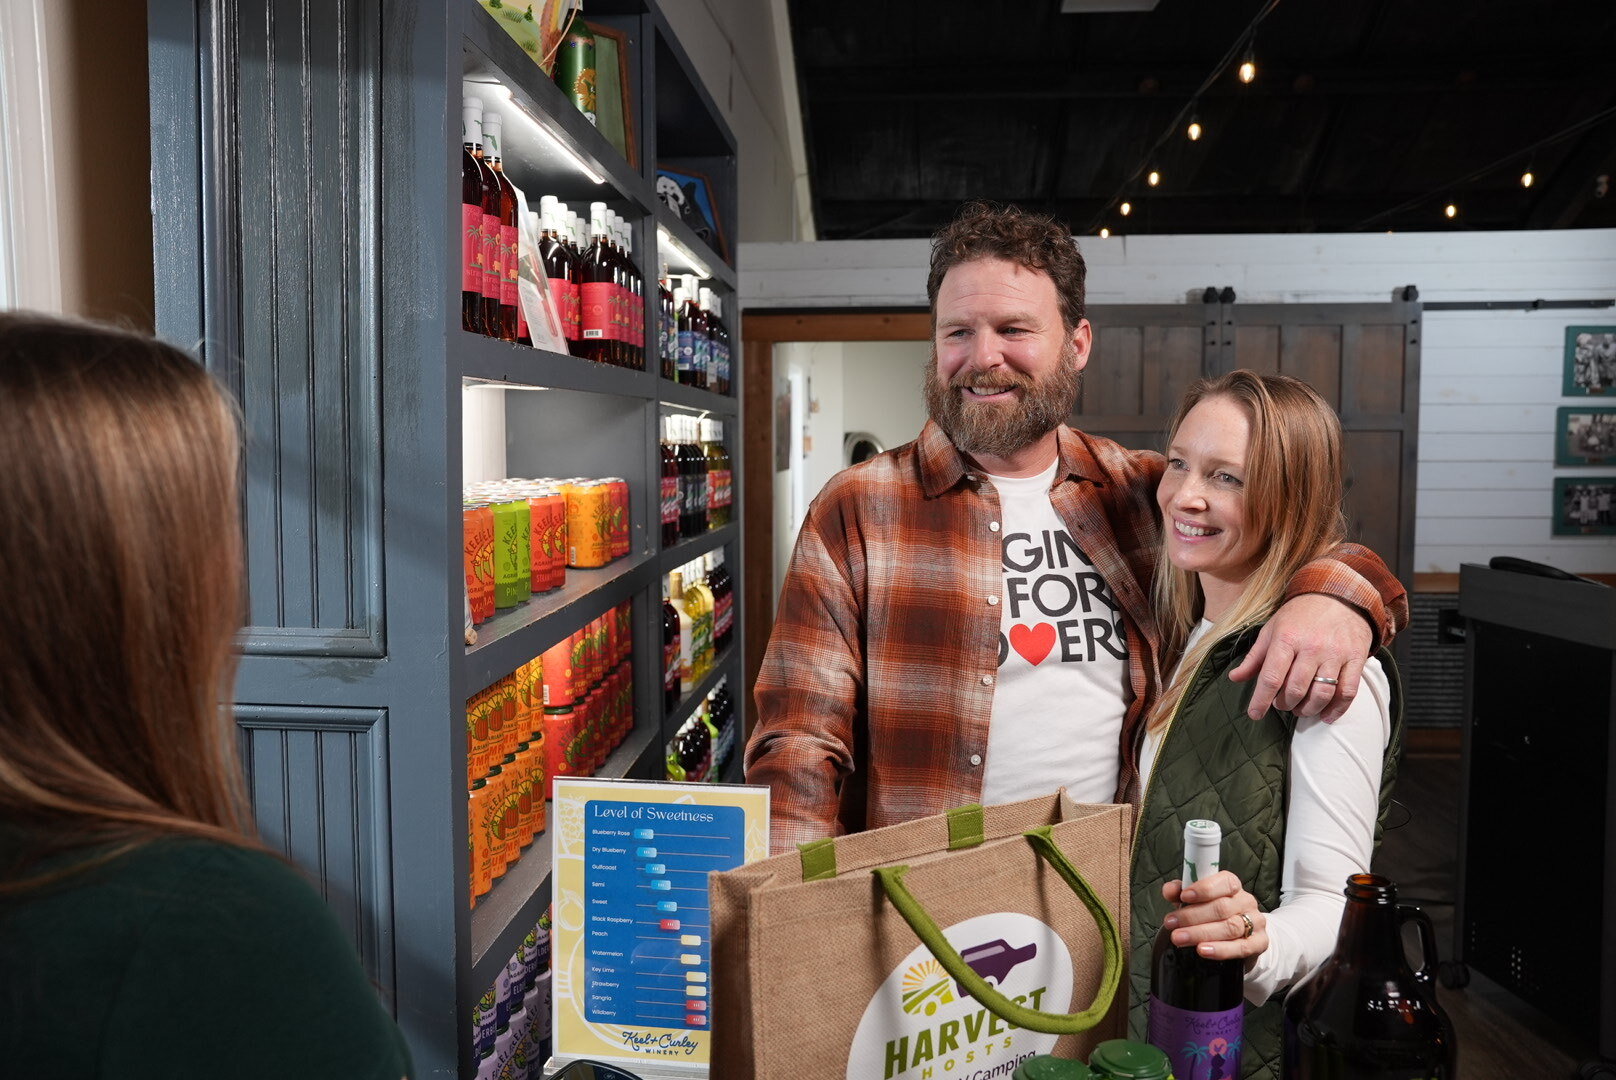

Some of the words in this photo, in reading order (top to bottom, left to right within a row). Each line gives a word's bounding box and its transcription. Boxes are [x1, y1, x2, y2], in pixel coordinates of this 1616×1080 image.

[1002, 530, 1094, 573] GIN
[1007, 572, 1120, 618] FOR
[594, 805, 627, 819] Level
[631, 806, 644, 819] of
[647, 807, 714, 823] Sweetness
[607, 917, 634, 925] Raspberry
[591, 981, 620, 989] Strawberry
[591, 1009, 617, 1017] Wildberry
[622, 1032, 652, 1051] Keel
[658, 1034, 699, 1055] Curley
[922, 1036, 1013, 1079] HOSTS
